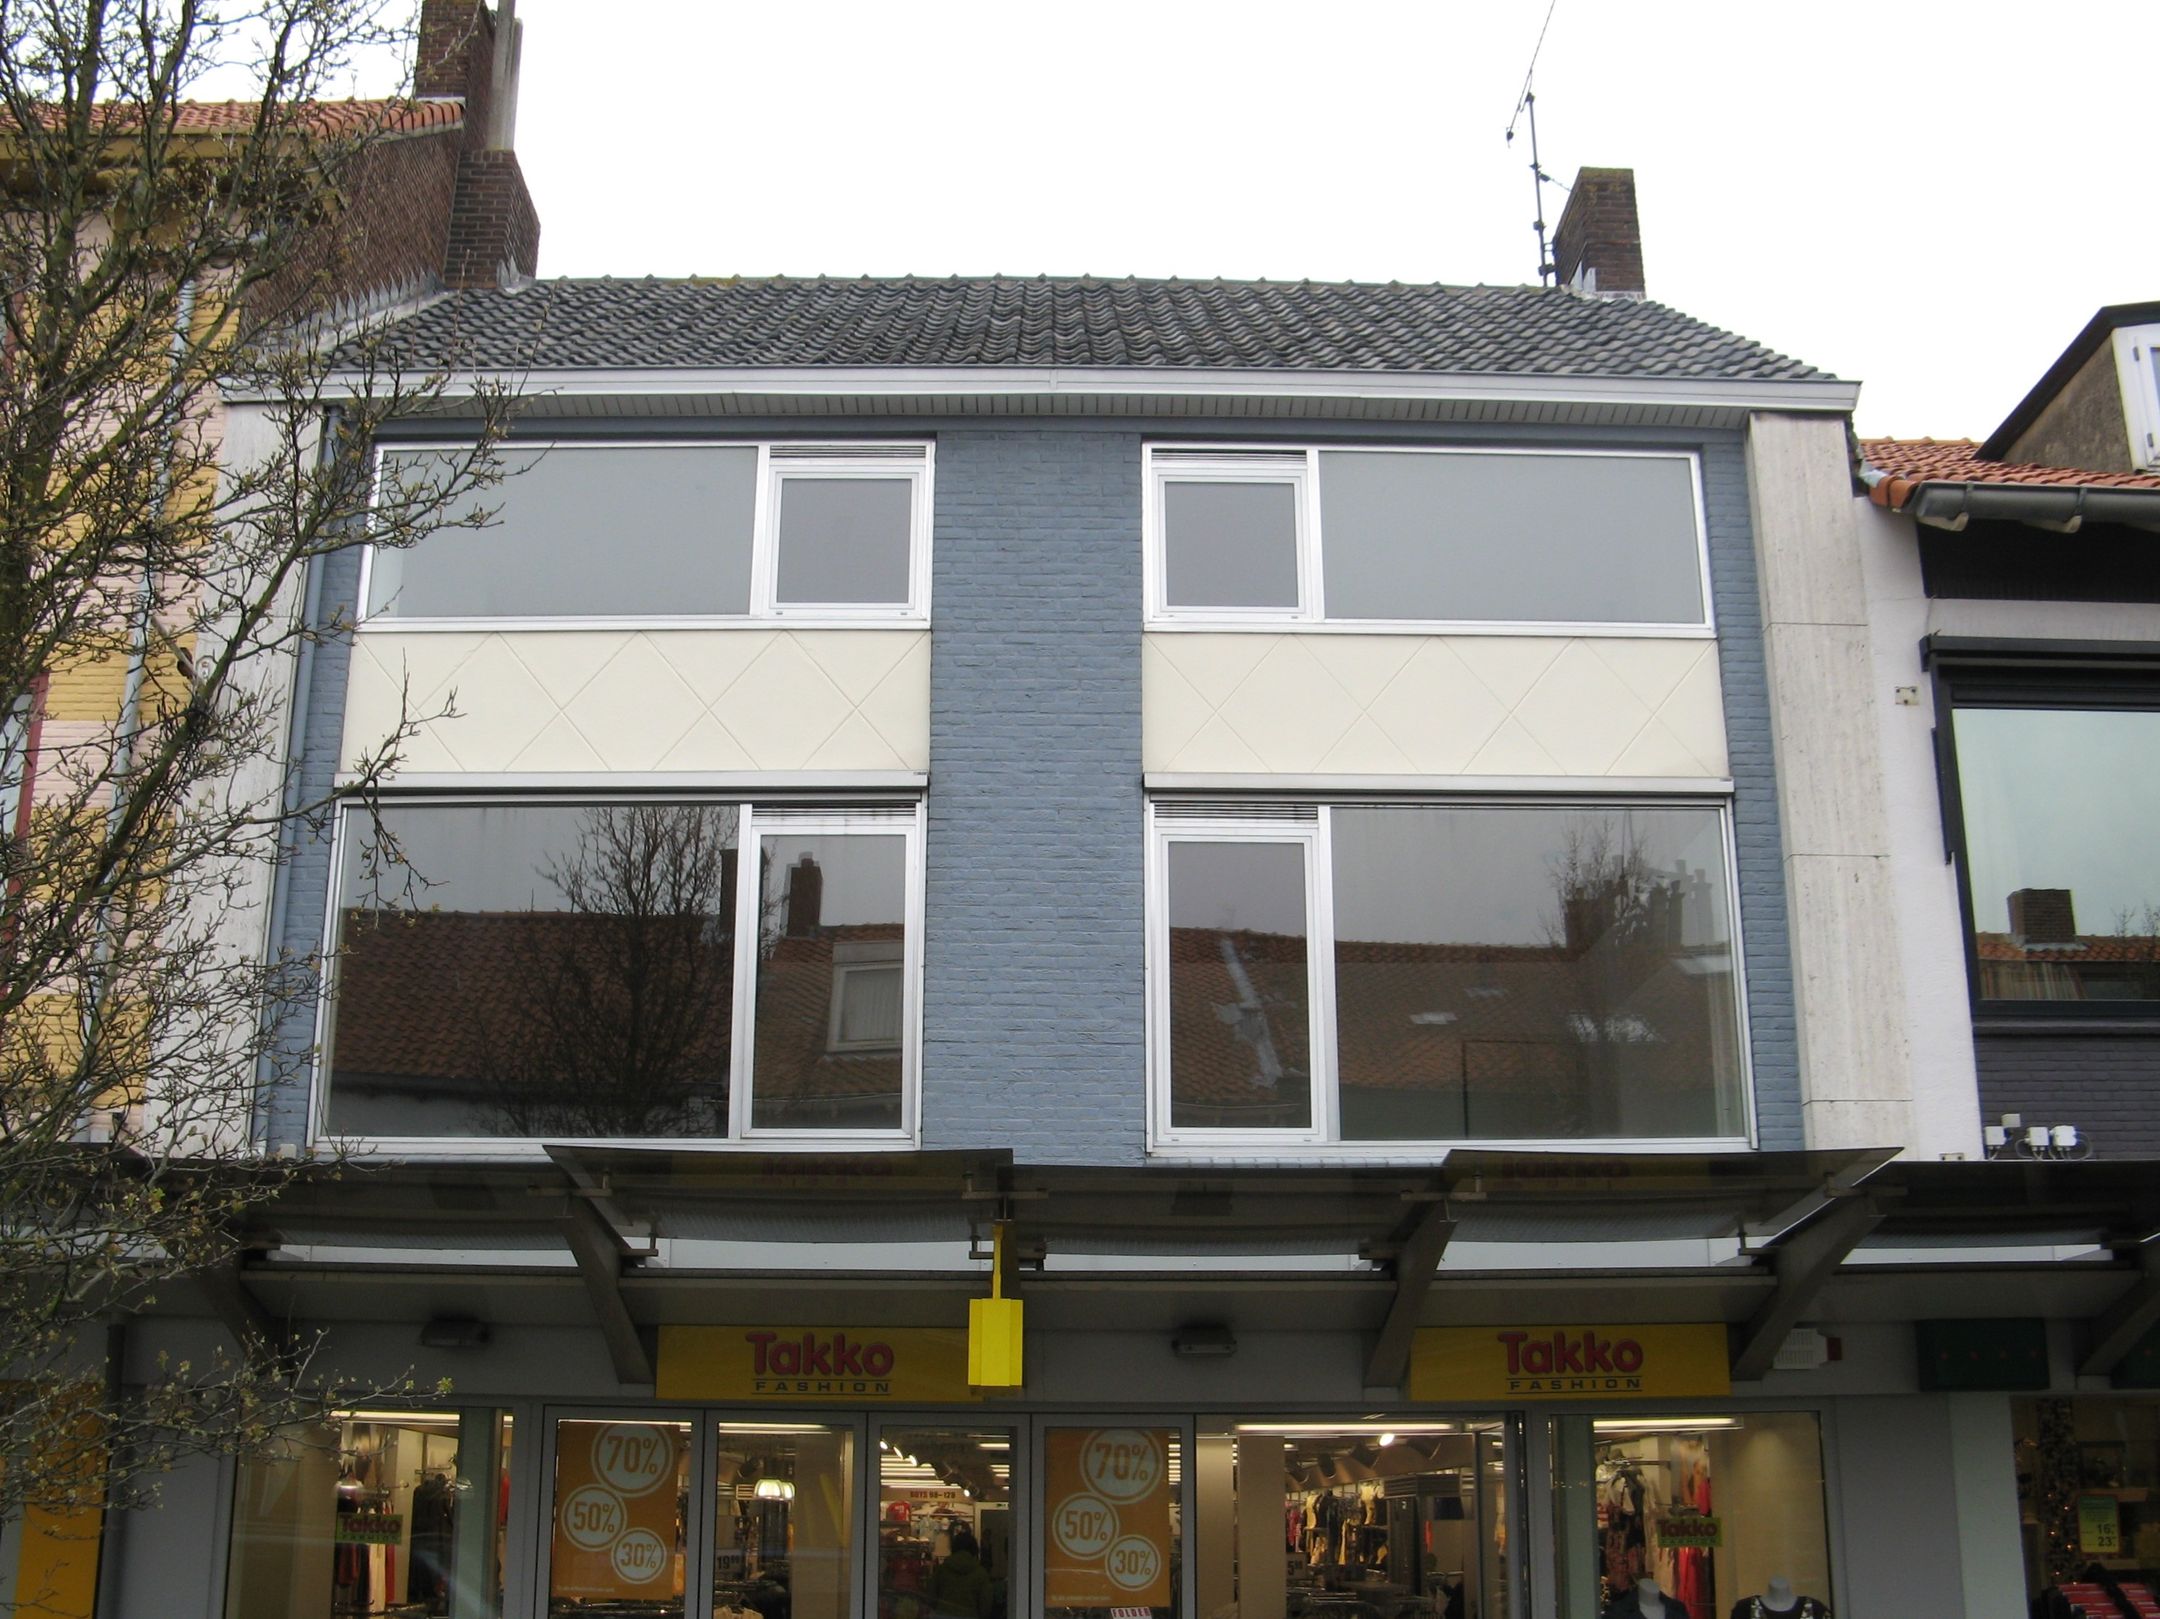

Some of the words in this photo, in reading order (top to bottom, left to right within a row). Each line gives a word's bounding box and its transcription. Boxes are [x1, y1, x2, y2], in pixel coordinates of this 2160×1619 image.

[745, 1331, 894, 1377] Takko
[1497, 1330, 1644, 1375] Takko
[756, 1382, 889, 1392] FASHION
[1510, 1379, 1640, 1390] FASHION
[606, 1435, 658, 1474] 70%
[1095, 1442, 1149, 1481] 70%
[340, 1514, 400, 1533] Takko
[573, 1502, 616, 1533] 50%
[1065, 1510, 1109, 1541] 50%
[1656, 1518, 1718, 1537] Takko
[620, 1543, 658, 1569] 30%
[1115, 1550, 1152, 1576] 30%
